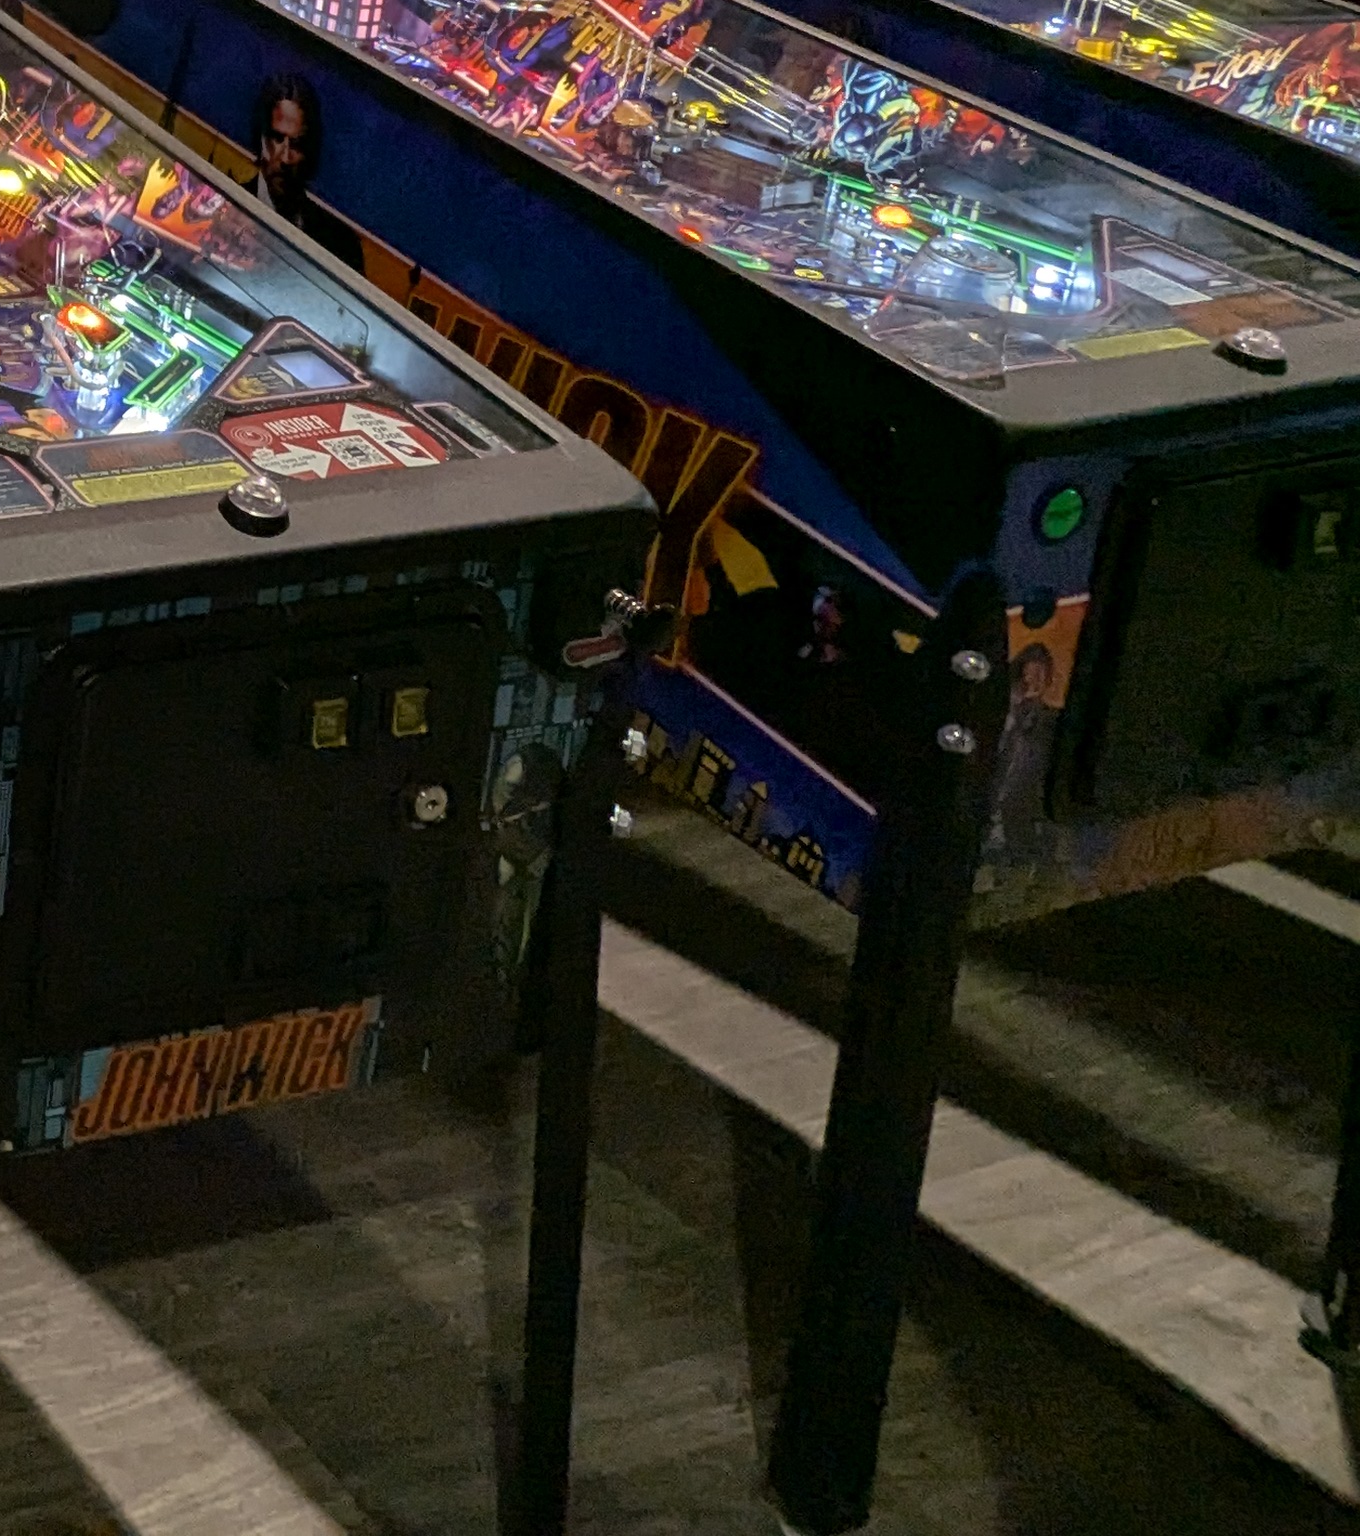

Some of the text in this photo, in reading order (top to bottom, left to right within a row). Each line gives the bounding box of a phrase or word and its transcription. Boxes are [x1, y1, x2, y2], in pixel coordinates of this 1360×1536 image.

[1177, 34, 1306, 92] ENOM
[264, 414, 332, 436] INSIDER
[372, 431, 404, 441] CODE
[73, 1001, 371, 1142] JOHN WICK
